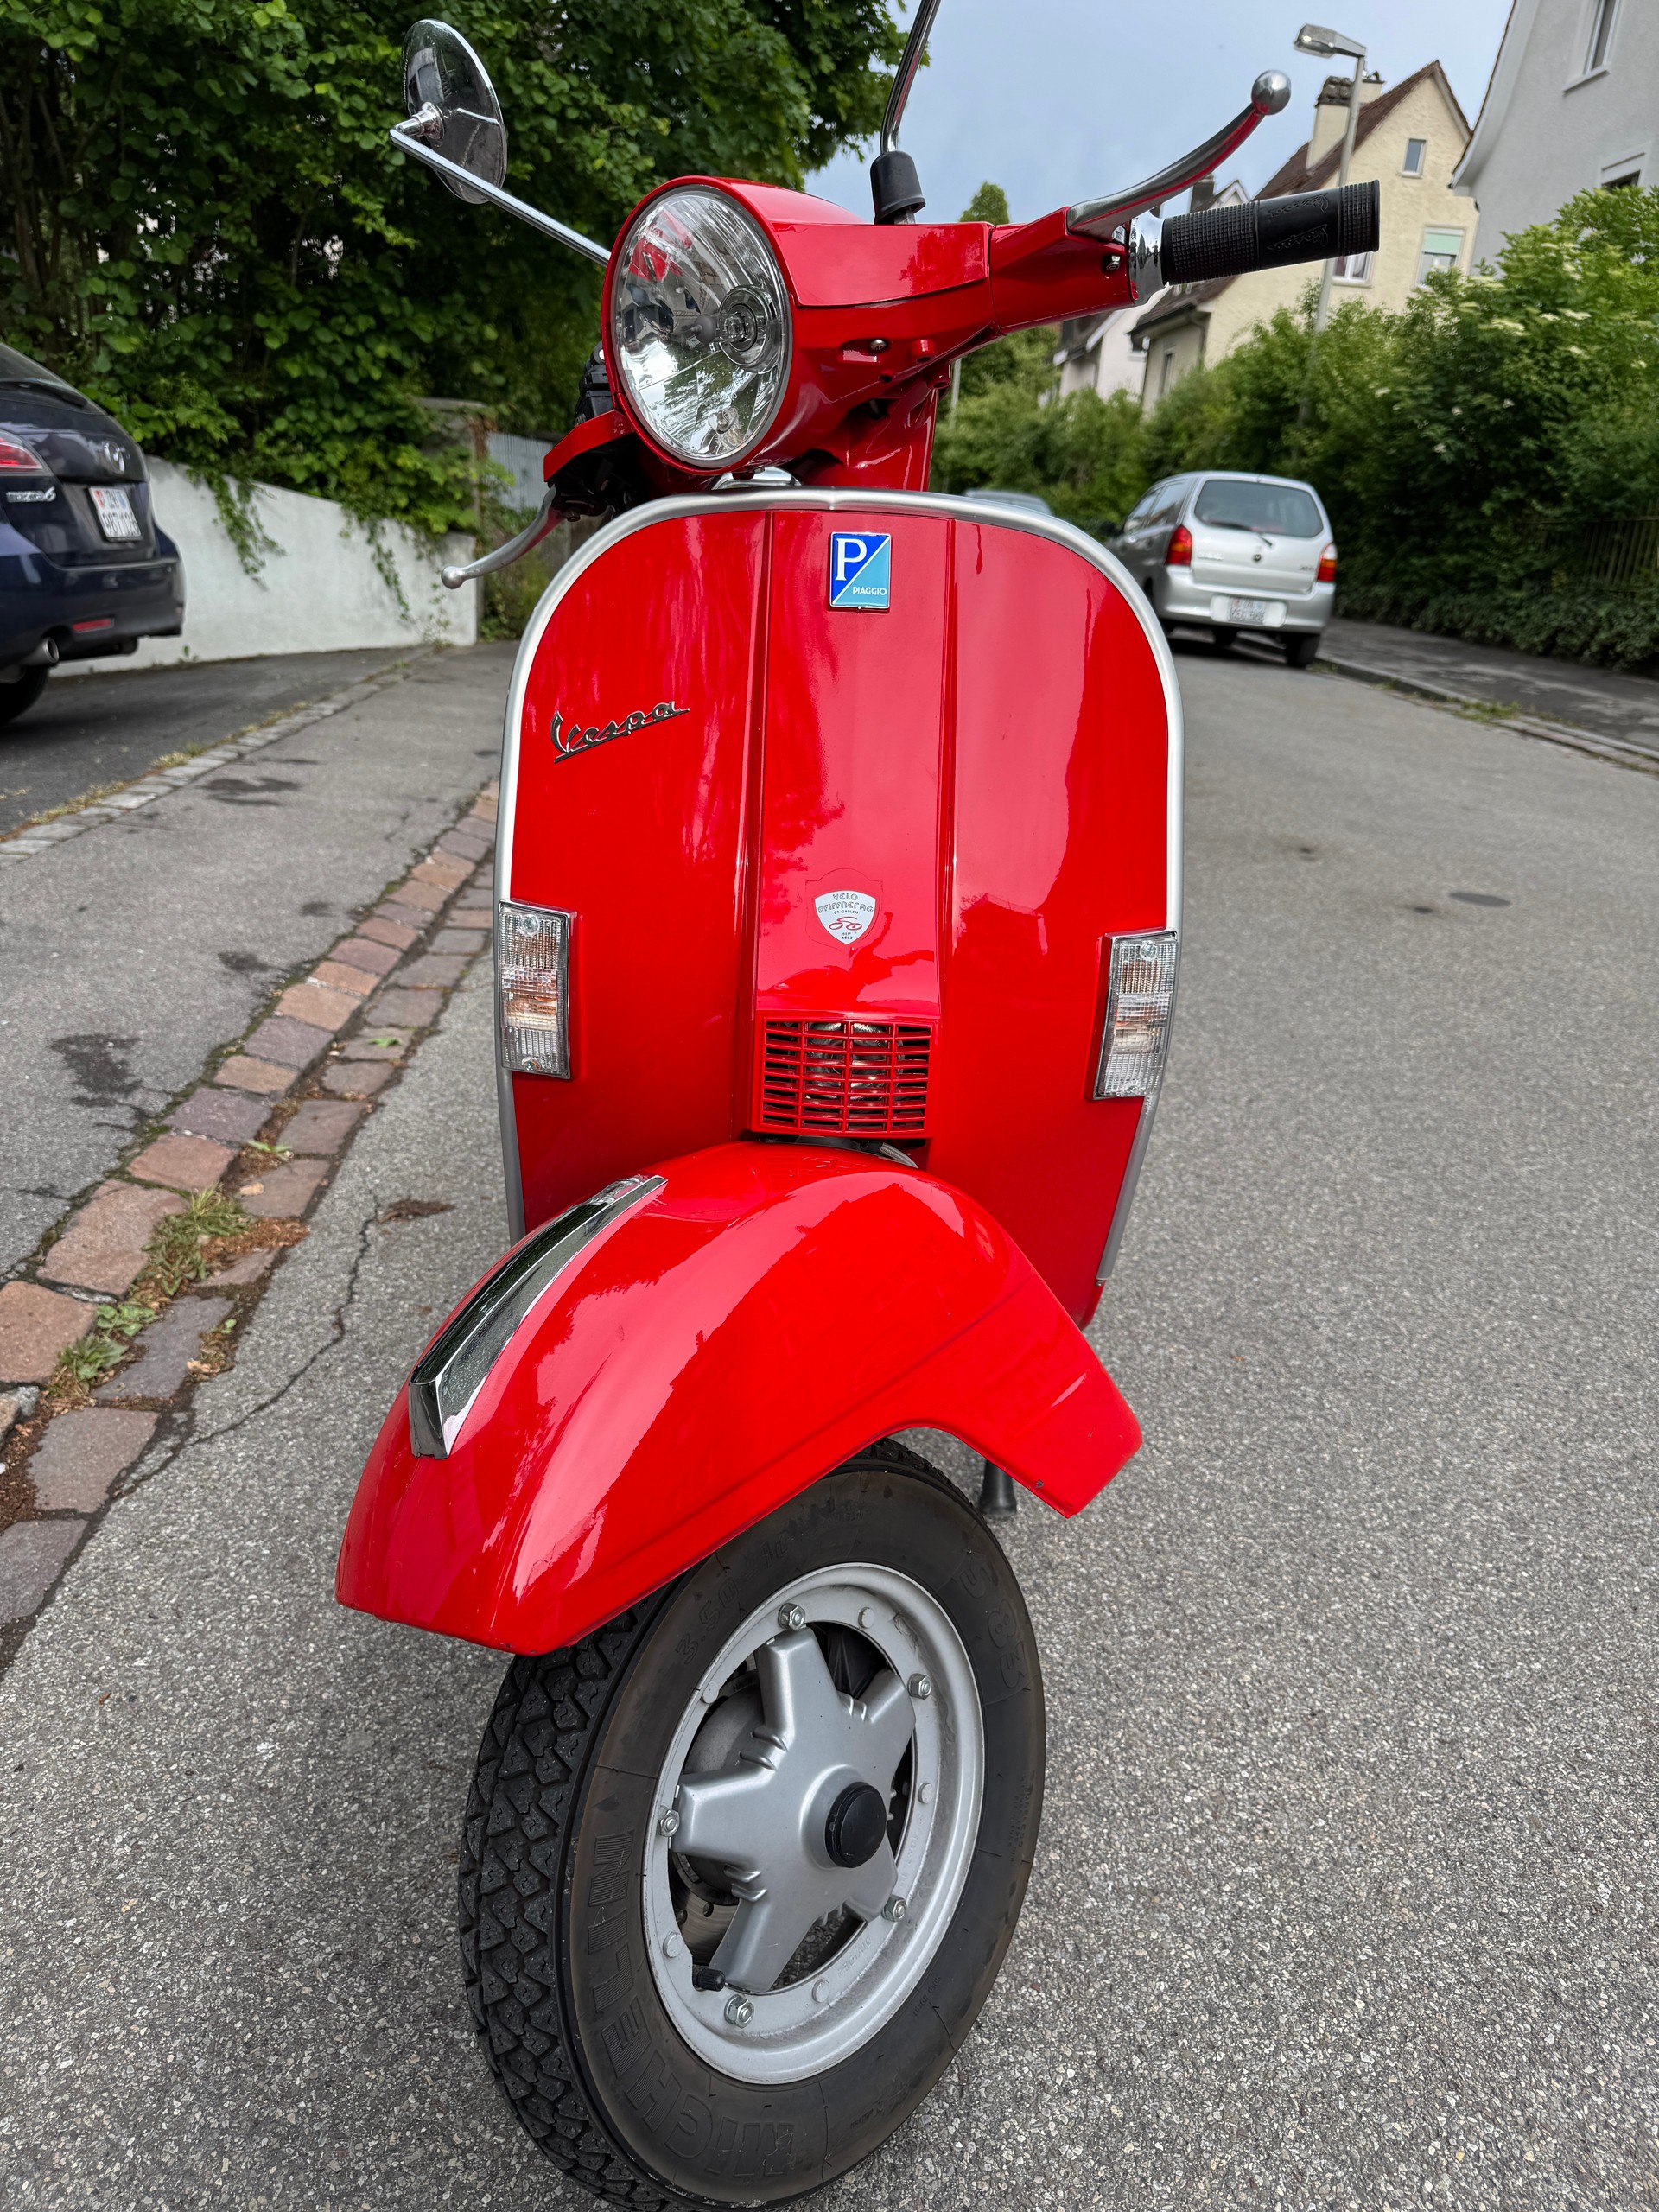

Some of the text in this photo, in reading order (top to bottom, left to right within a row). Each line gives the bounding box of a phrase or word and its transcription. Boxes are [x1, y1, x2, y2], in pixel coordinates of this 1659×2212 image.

[1267, 224, 1328, 251] Vespa
[835, 537, 868, 581] P
[852, 586, 887, 596] PIAGGIO
[549, 701, 690, 763] Vespa
[588, 1828, 797, 2177] MICHELIN
